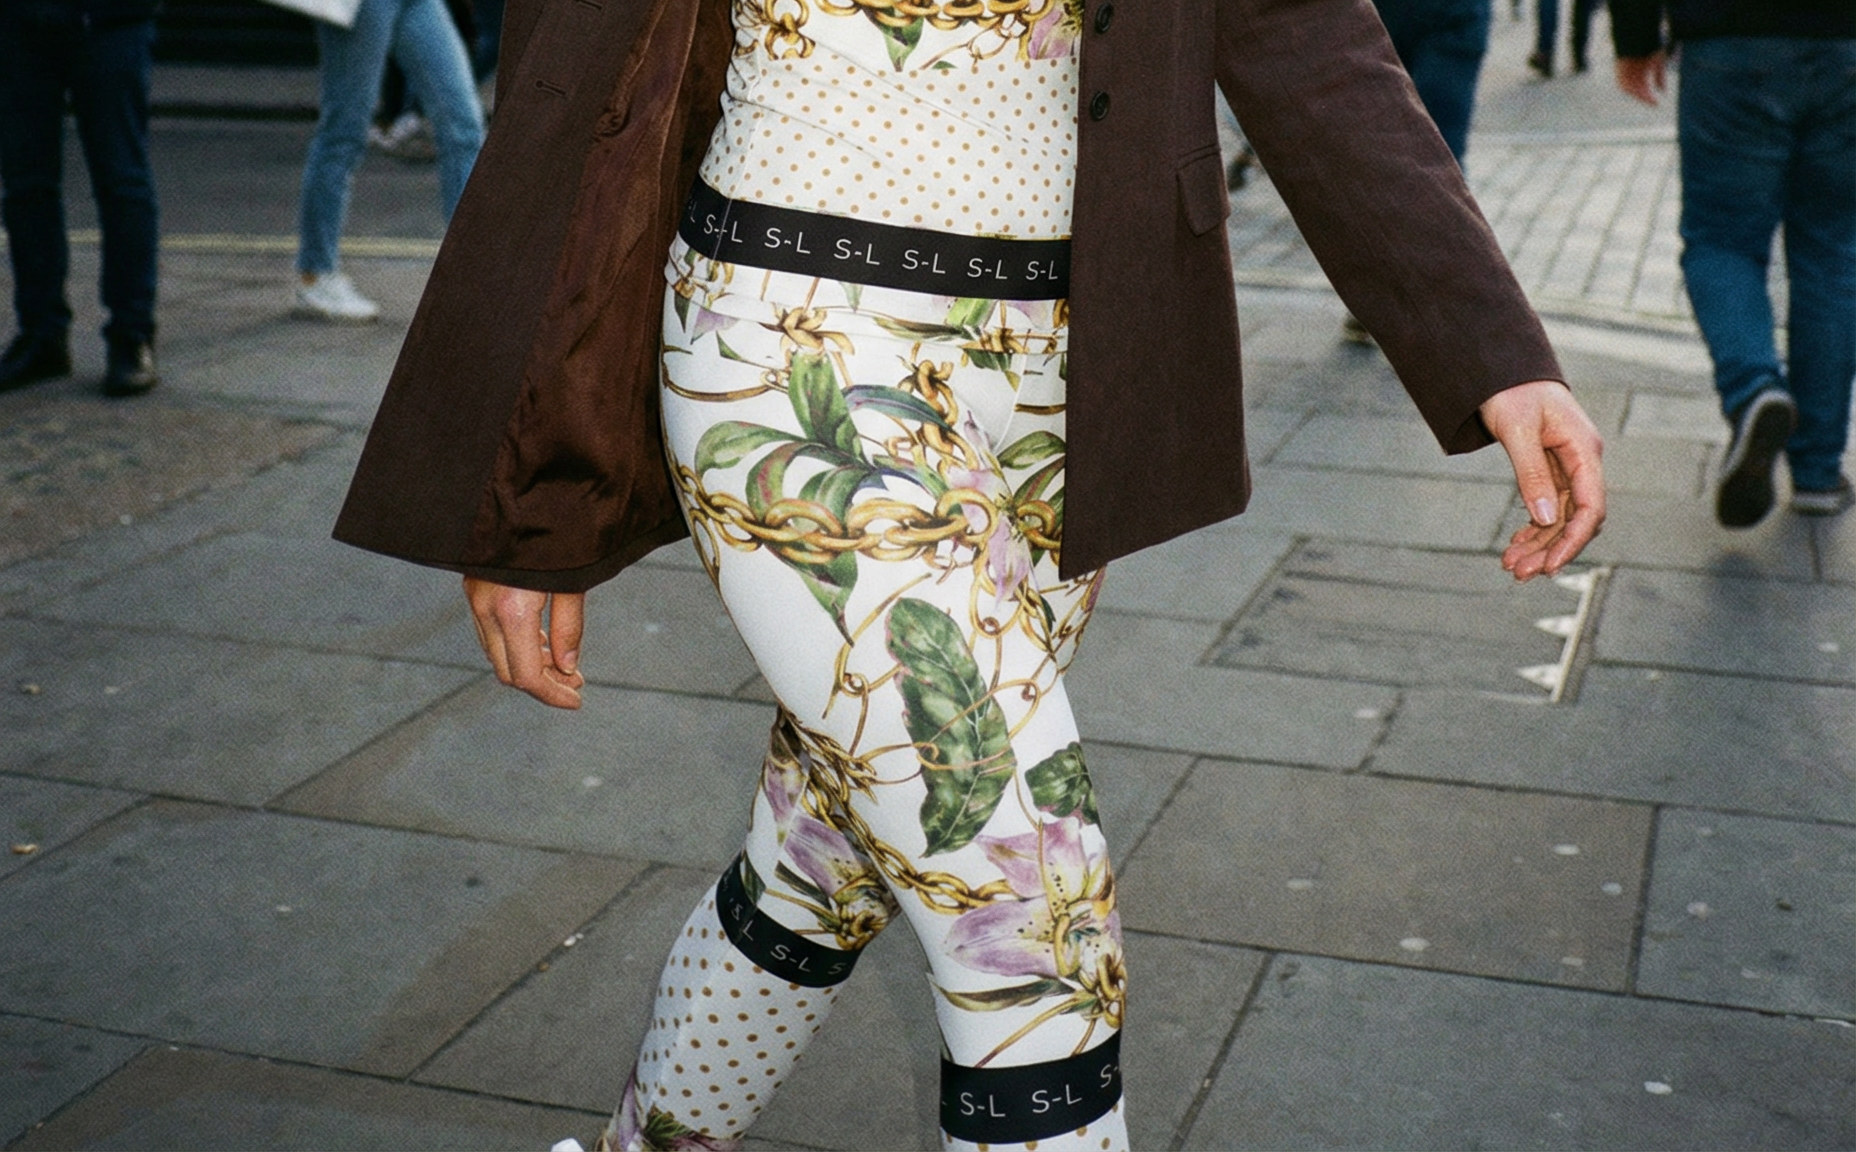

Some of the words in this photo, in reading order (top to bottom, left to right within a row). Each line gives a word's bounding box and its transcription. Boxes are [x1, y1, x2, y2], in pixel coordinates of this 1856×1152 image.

[764, 227, 811, 254] S-L
[833, 239, 880, 266] S-L
[902, 249, 946, 274] S-L
[966, 258, 1008, 280] S-L
[1025, 260, 1059, 281] S-L
[770, 944, 811, 972] S-L
[960, 1092, 1006, 1117] S-L
[1031, 1083, 1082, 1113] S-L
